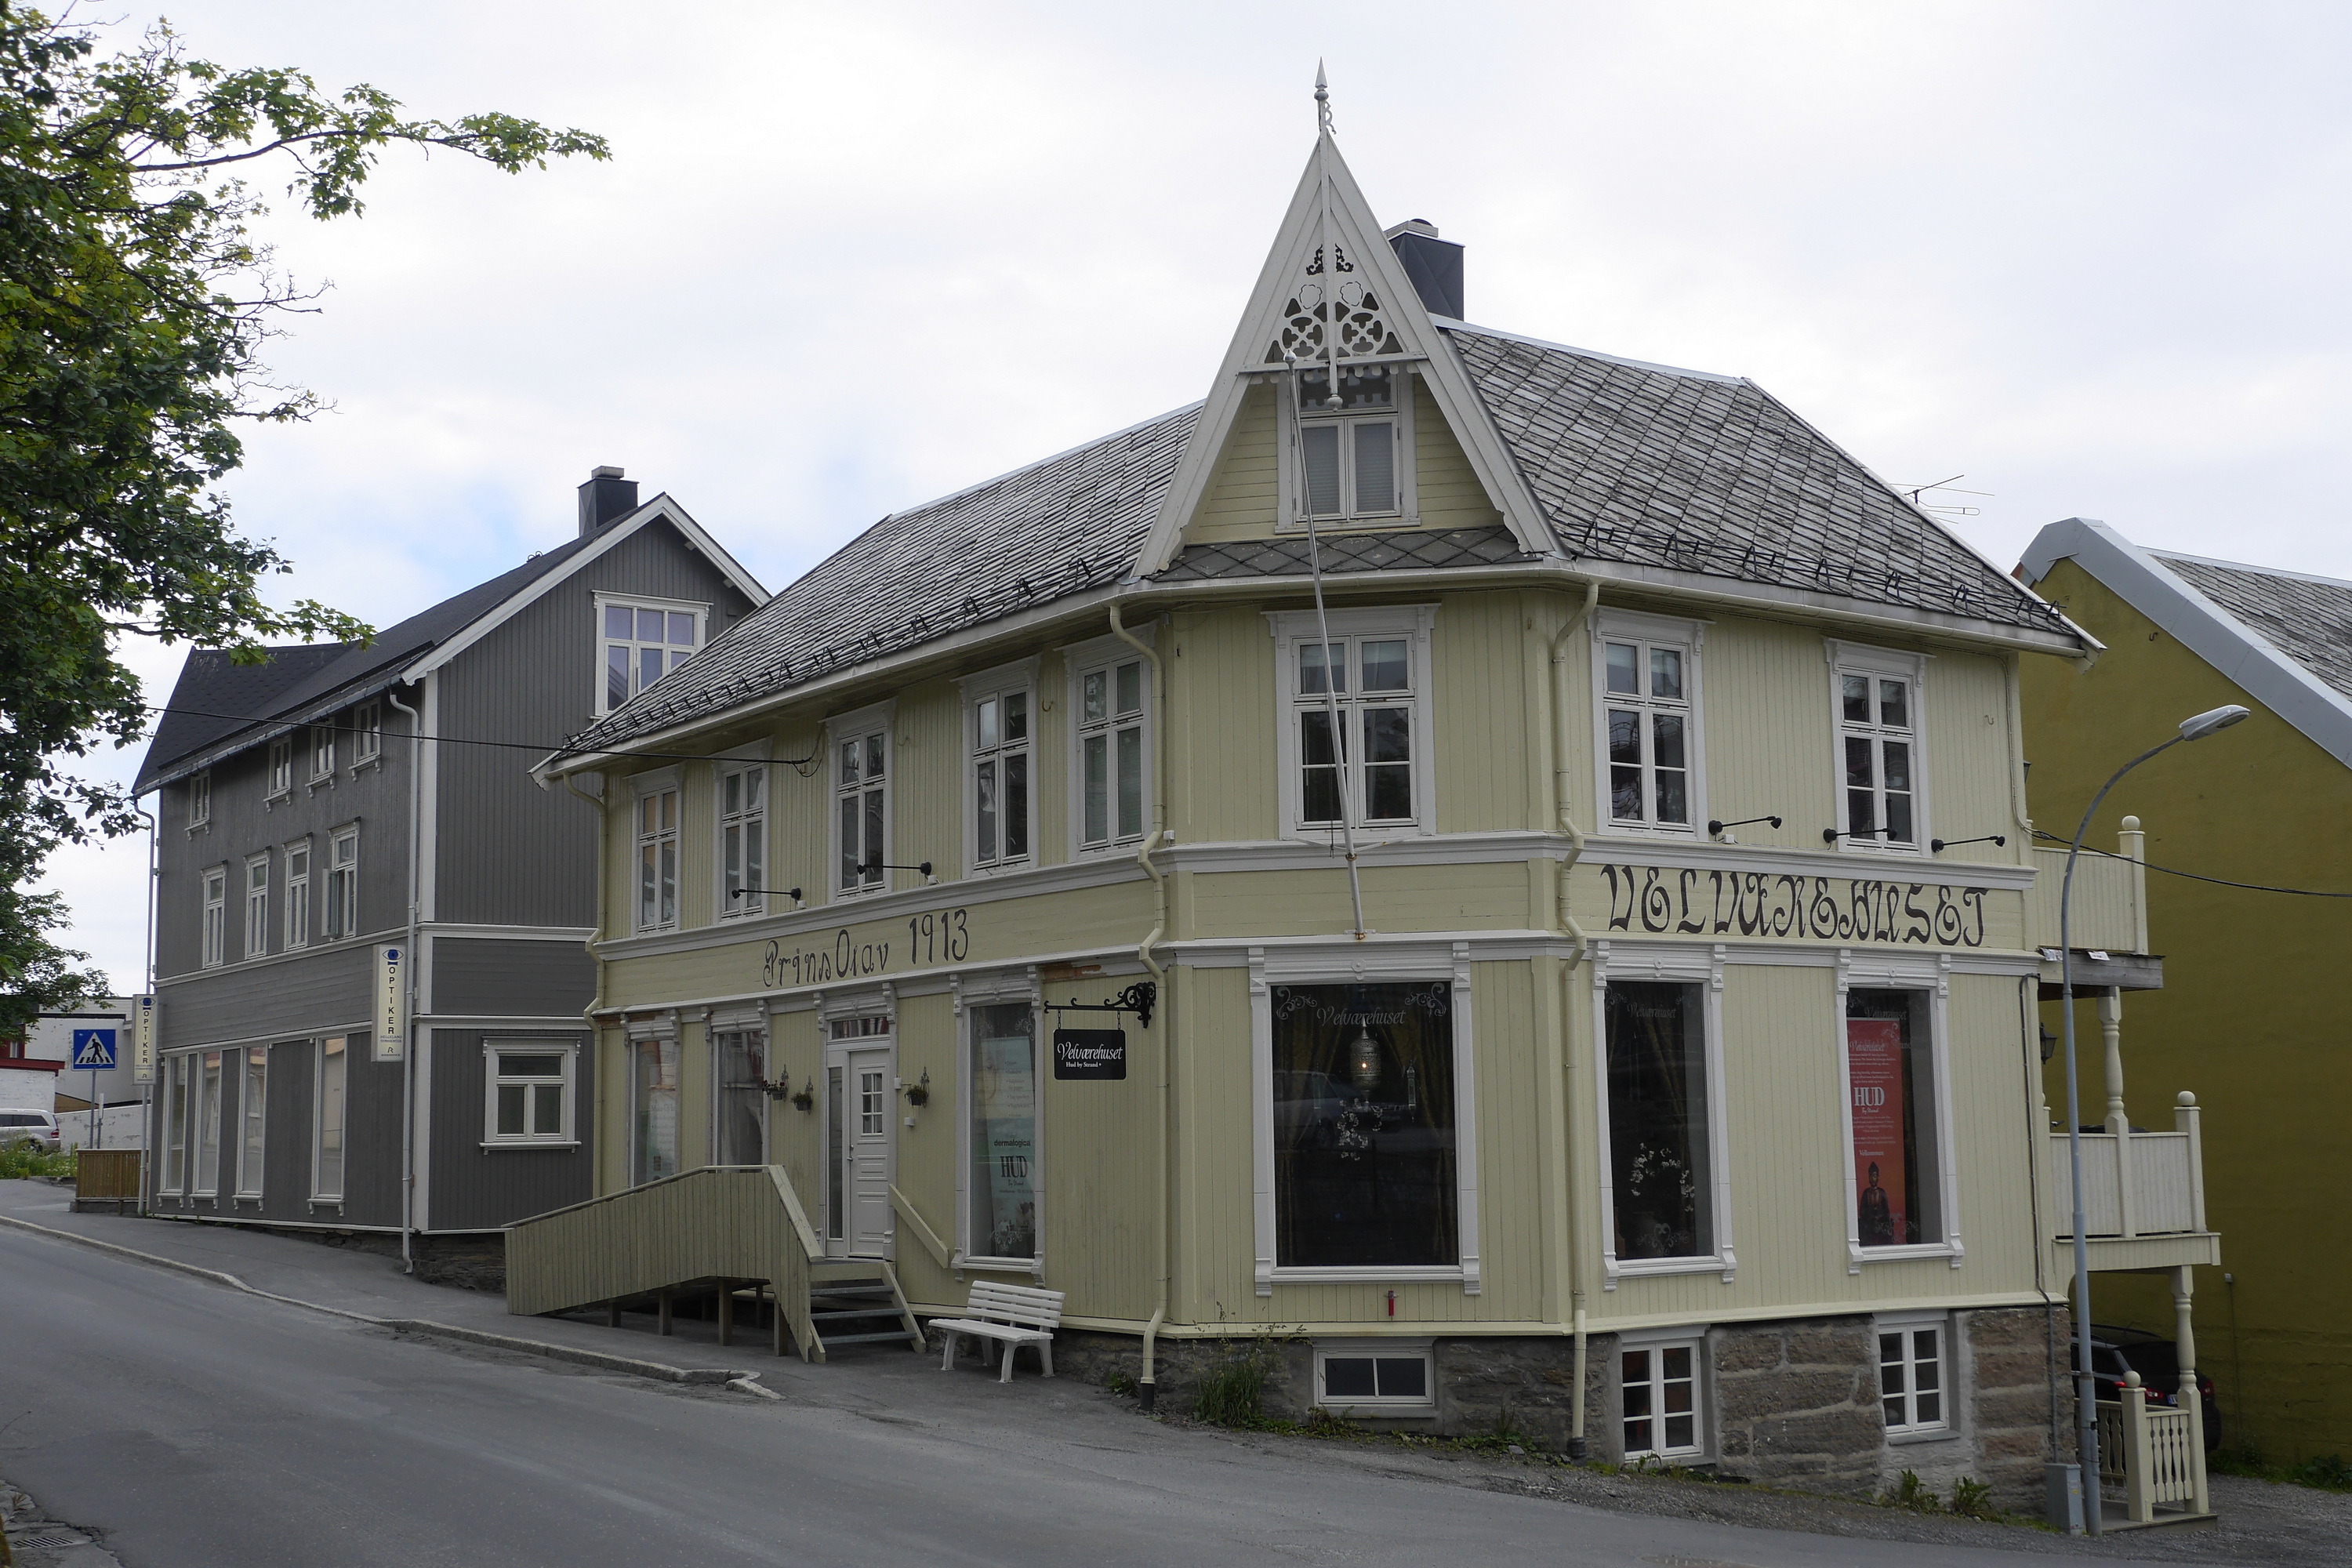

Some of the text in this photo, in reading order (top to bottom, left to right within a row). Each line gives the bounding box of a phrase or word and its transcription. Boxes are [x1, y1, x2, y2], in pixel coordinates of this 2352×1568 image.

[909, 909, 969, 965] 1913
[1057, 1041, 1123, 1061] Velværehuset
[1853, 1087, 1886, 1106] HUD
[1000, 1156, 1029, 1178] HUD
